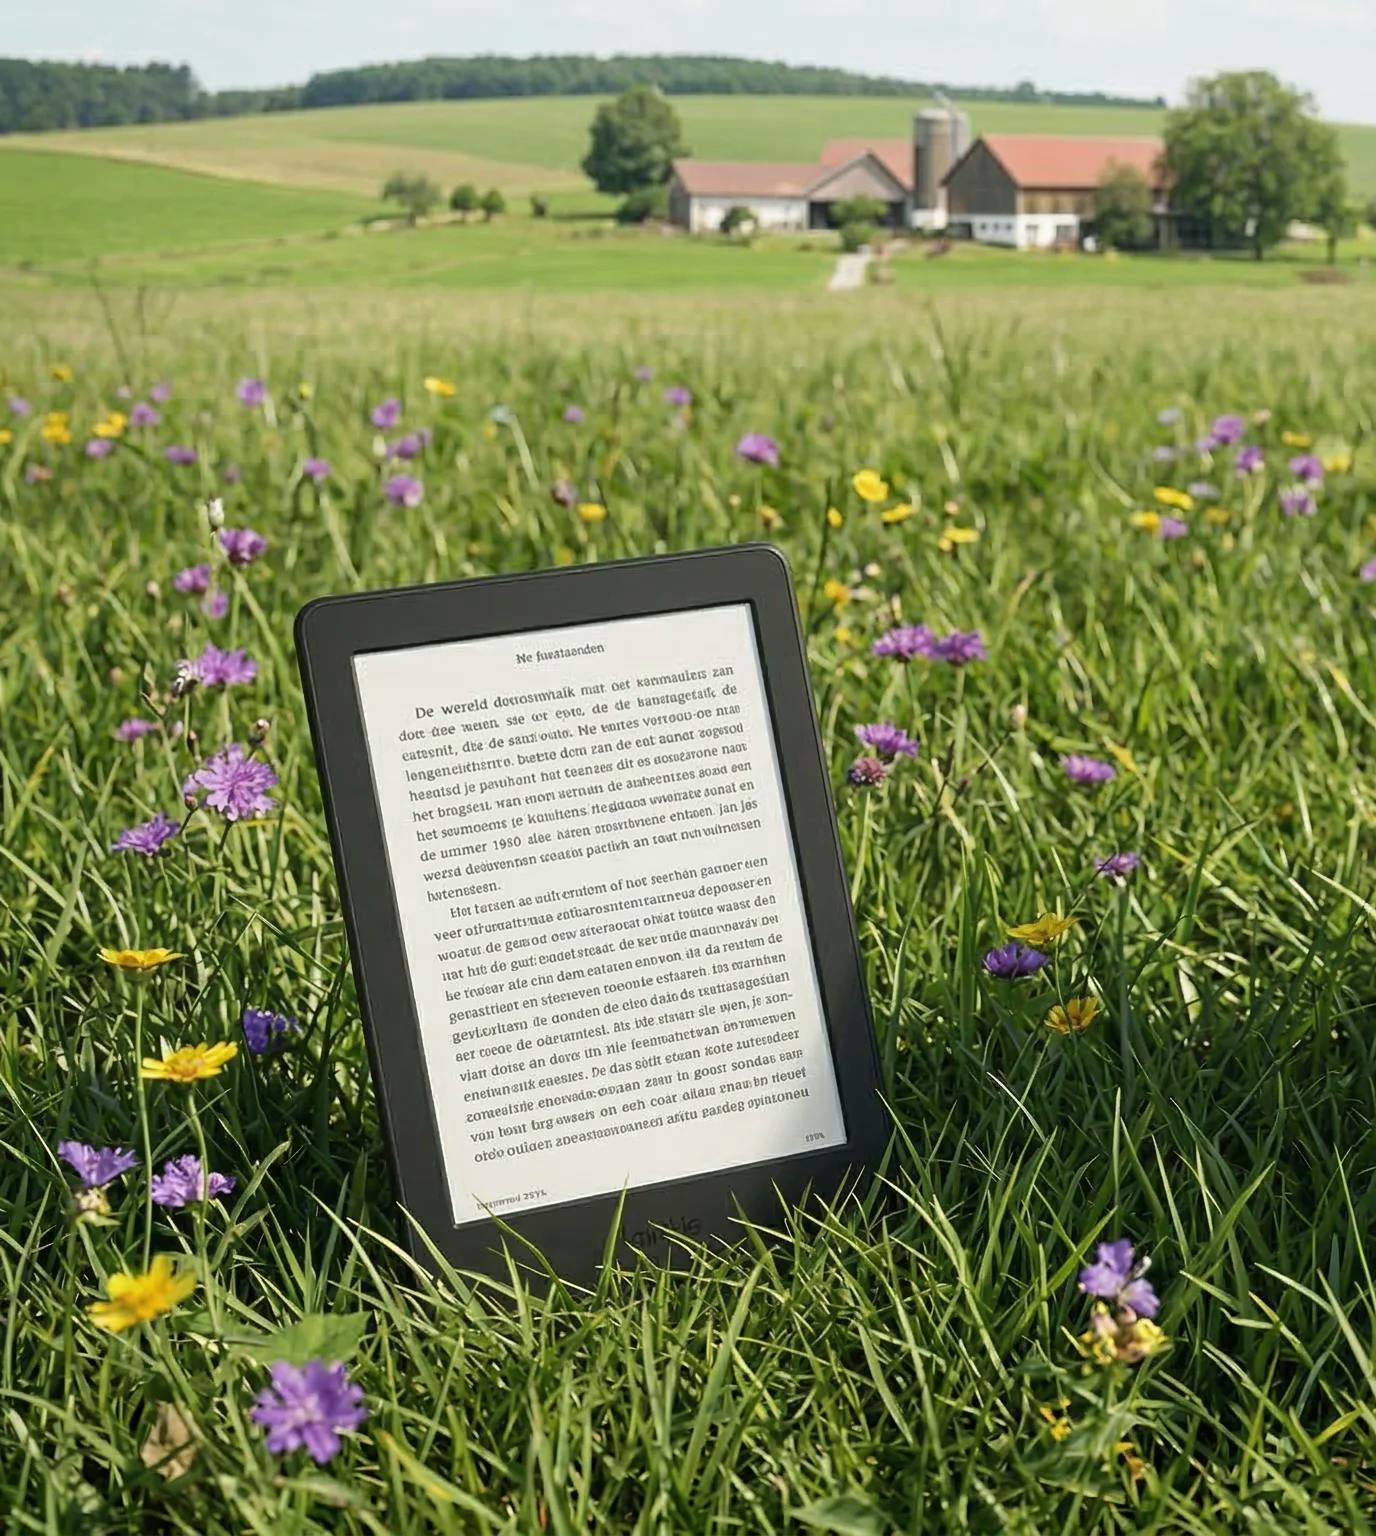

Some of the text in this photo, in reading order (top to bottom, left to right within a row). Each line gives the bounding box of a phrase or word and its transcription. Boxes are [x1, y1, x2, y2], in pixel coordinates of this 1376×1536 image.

[415, 706, 434, 719] De
[440, 697, 489, 715] wereld
[712, 666, 734, 678] zan
[591, 703, 608, 714] de
[721, 683, 737, 696] de
[485, 737, 504, 749] de
[615, 738, 632, 751] de
[464, 781, 476, 796] je
[636, 757, 651, 768] es
[412, 809, 435, 822] het
[607, 780, 623, 792] de
[416, 828, 438, 842] het
[738, 781, 755, 791] en
[419, 850, 436, 862] de
[492, 835, 522, 850] 1980
[632, 837, 650, 848] an
[609, 878, 623, 892] of
[485, 941, 502, 954] de
[618, 938, 635, 951] de
[704, 943, 721, 956] da
[767, 932, 783, 944] de
[522, 998, 538, 1009] en
[603, 1002, 619, 1014] de
[516, 1038, 533, 1051] de
[528, 1058, 546, 1069] an
[609, 1061, 633, 1074] das
[599, 1105, 618, 1118] on
